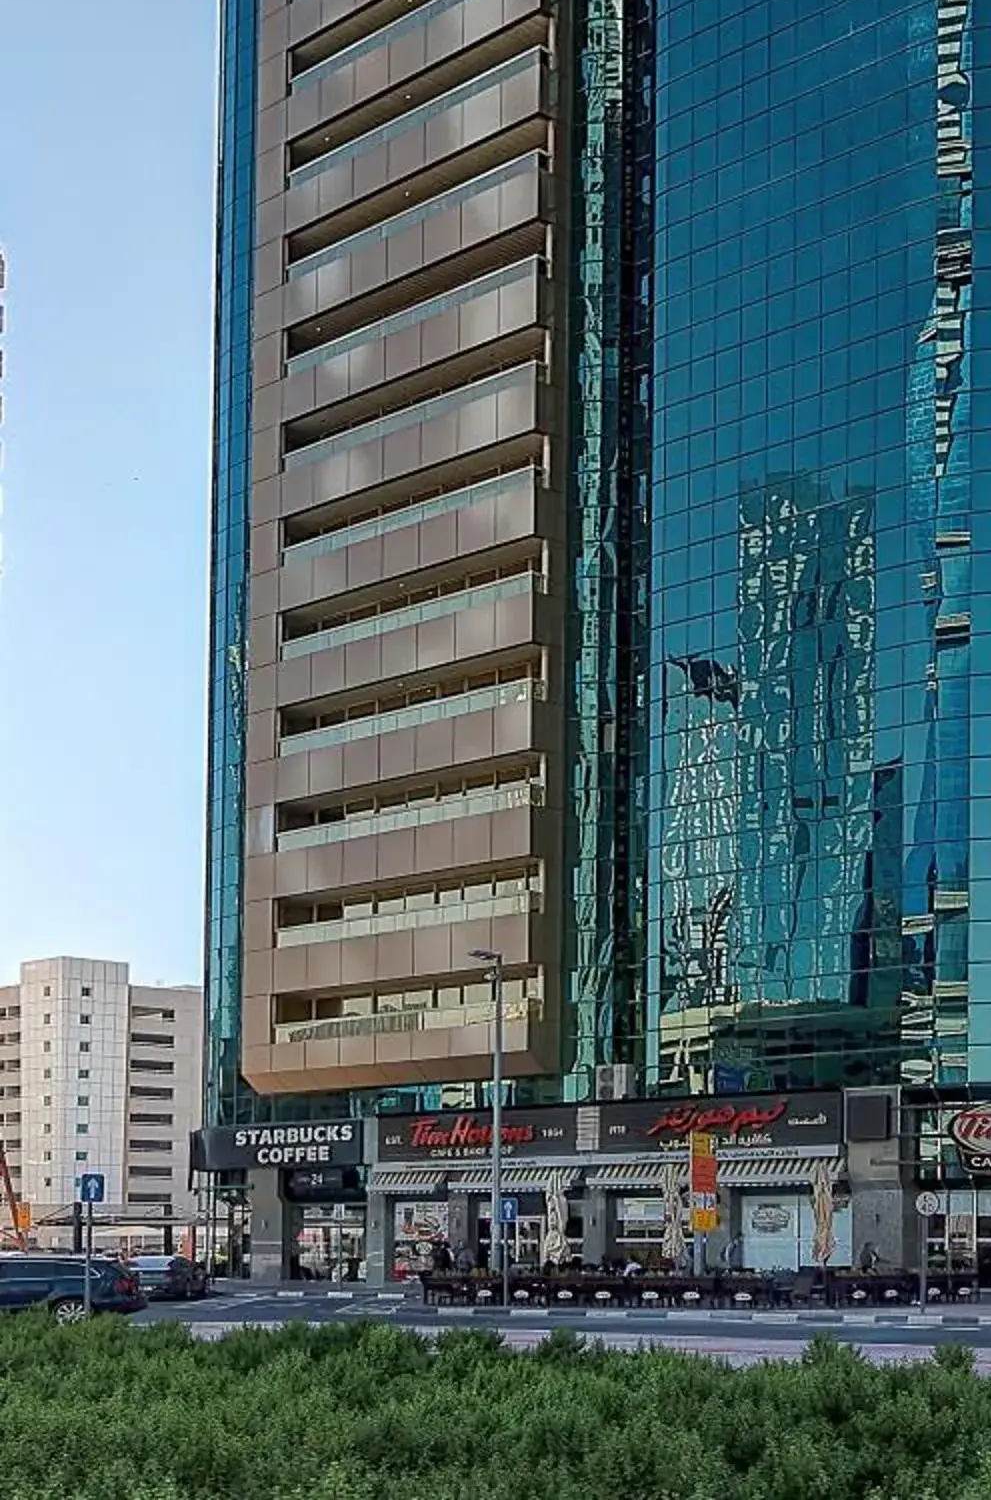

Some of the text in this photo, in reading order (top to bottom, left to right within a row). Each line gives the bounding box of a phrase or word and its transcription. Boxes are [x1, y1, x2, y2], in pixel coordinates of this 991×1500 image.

[235, 1125, 353, 1147] STARBUCKS
[410, 1117, 450, 1148] Tim
[450, 1116, 534, 1145] Horons
[257, 1146, 330, 1164] COFFEE
